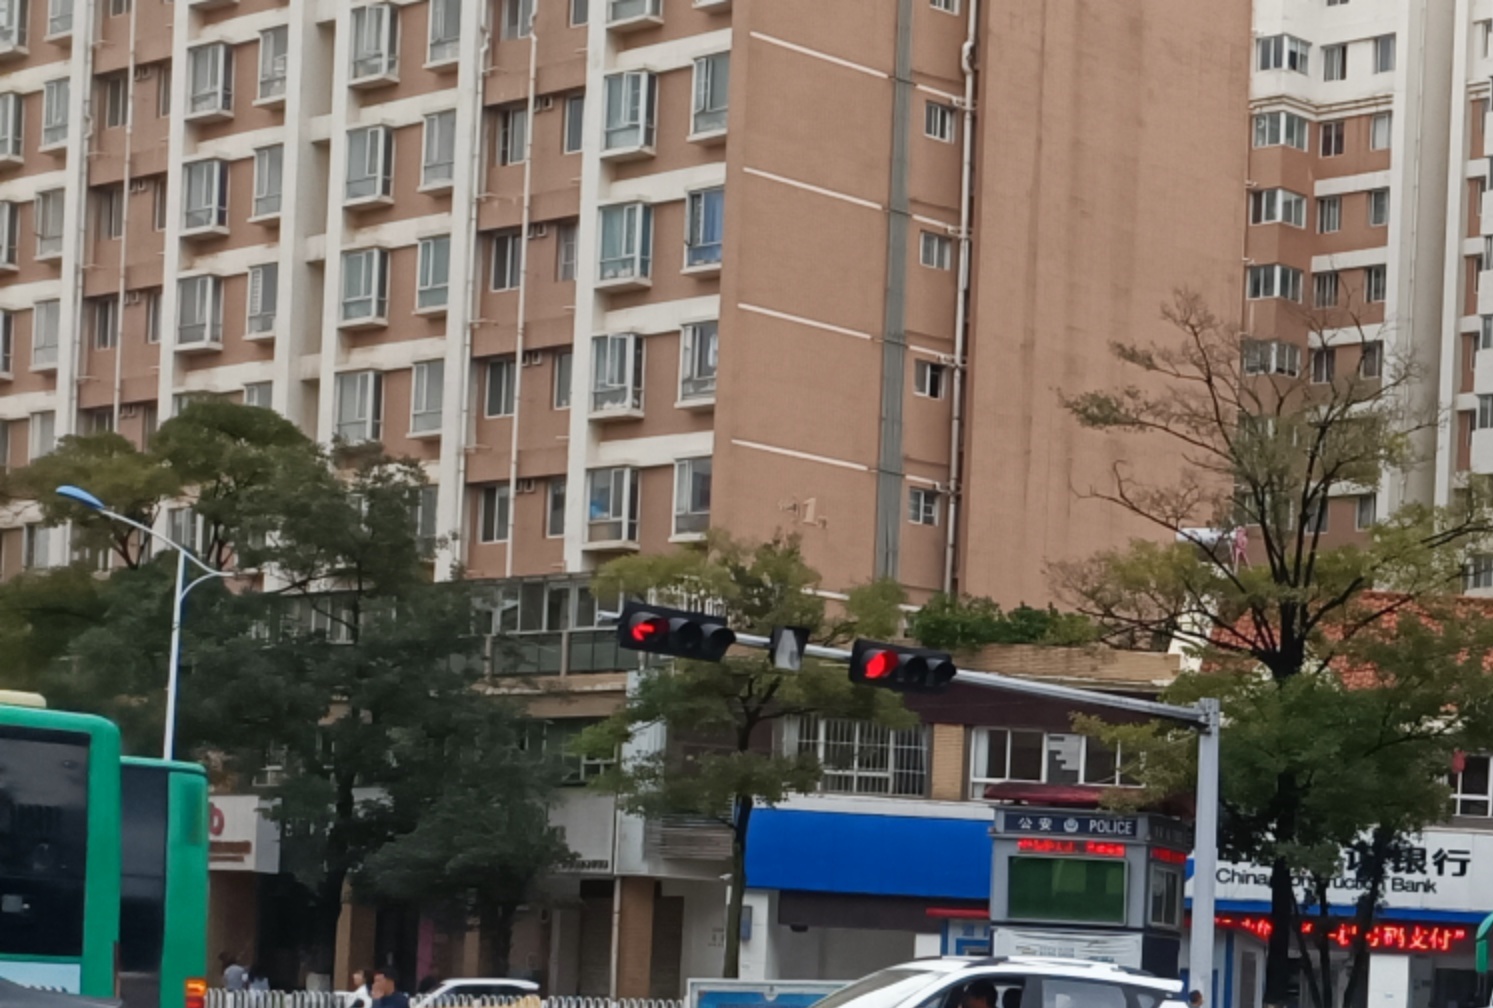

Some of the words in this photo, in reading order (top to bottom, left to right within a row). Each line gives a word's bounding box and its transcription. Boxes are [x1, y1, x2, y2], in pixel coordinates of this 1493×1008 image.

[1018, 816, 1053, 832] 公安
[1089, 818, 1132, 835] POLICE
[1215, 867, 1272, 887] China
[1391, 877, 1437, 894] Bank
